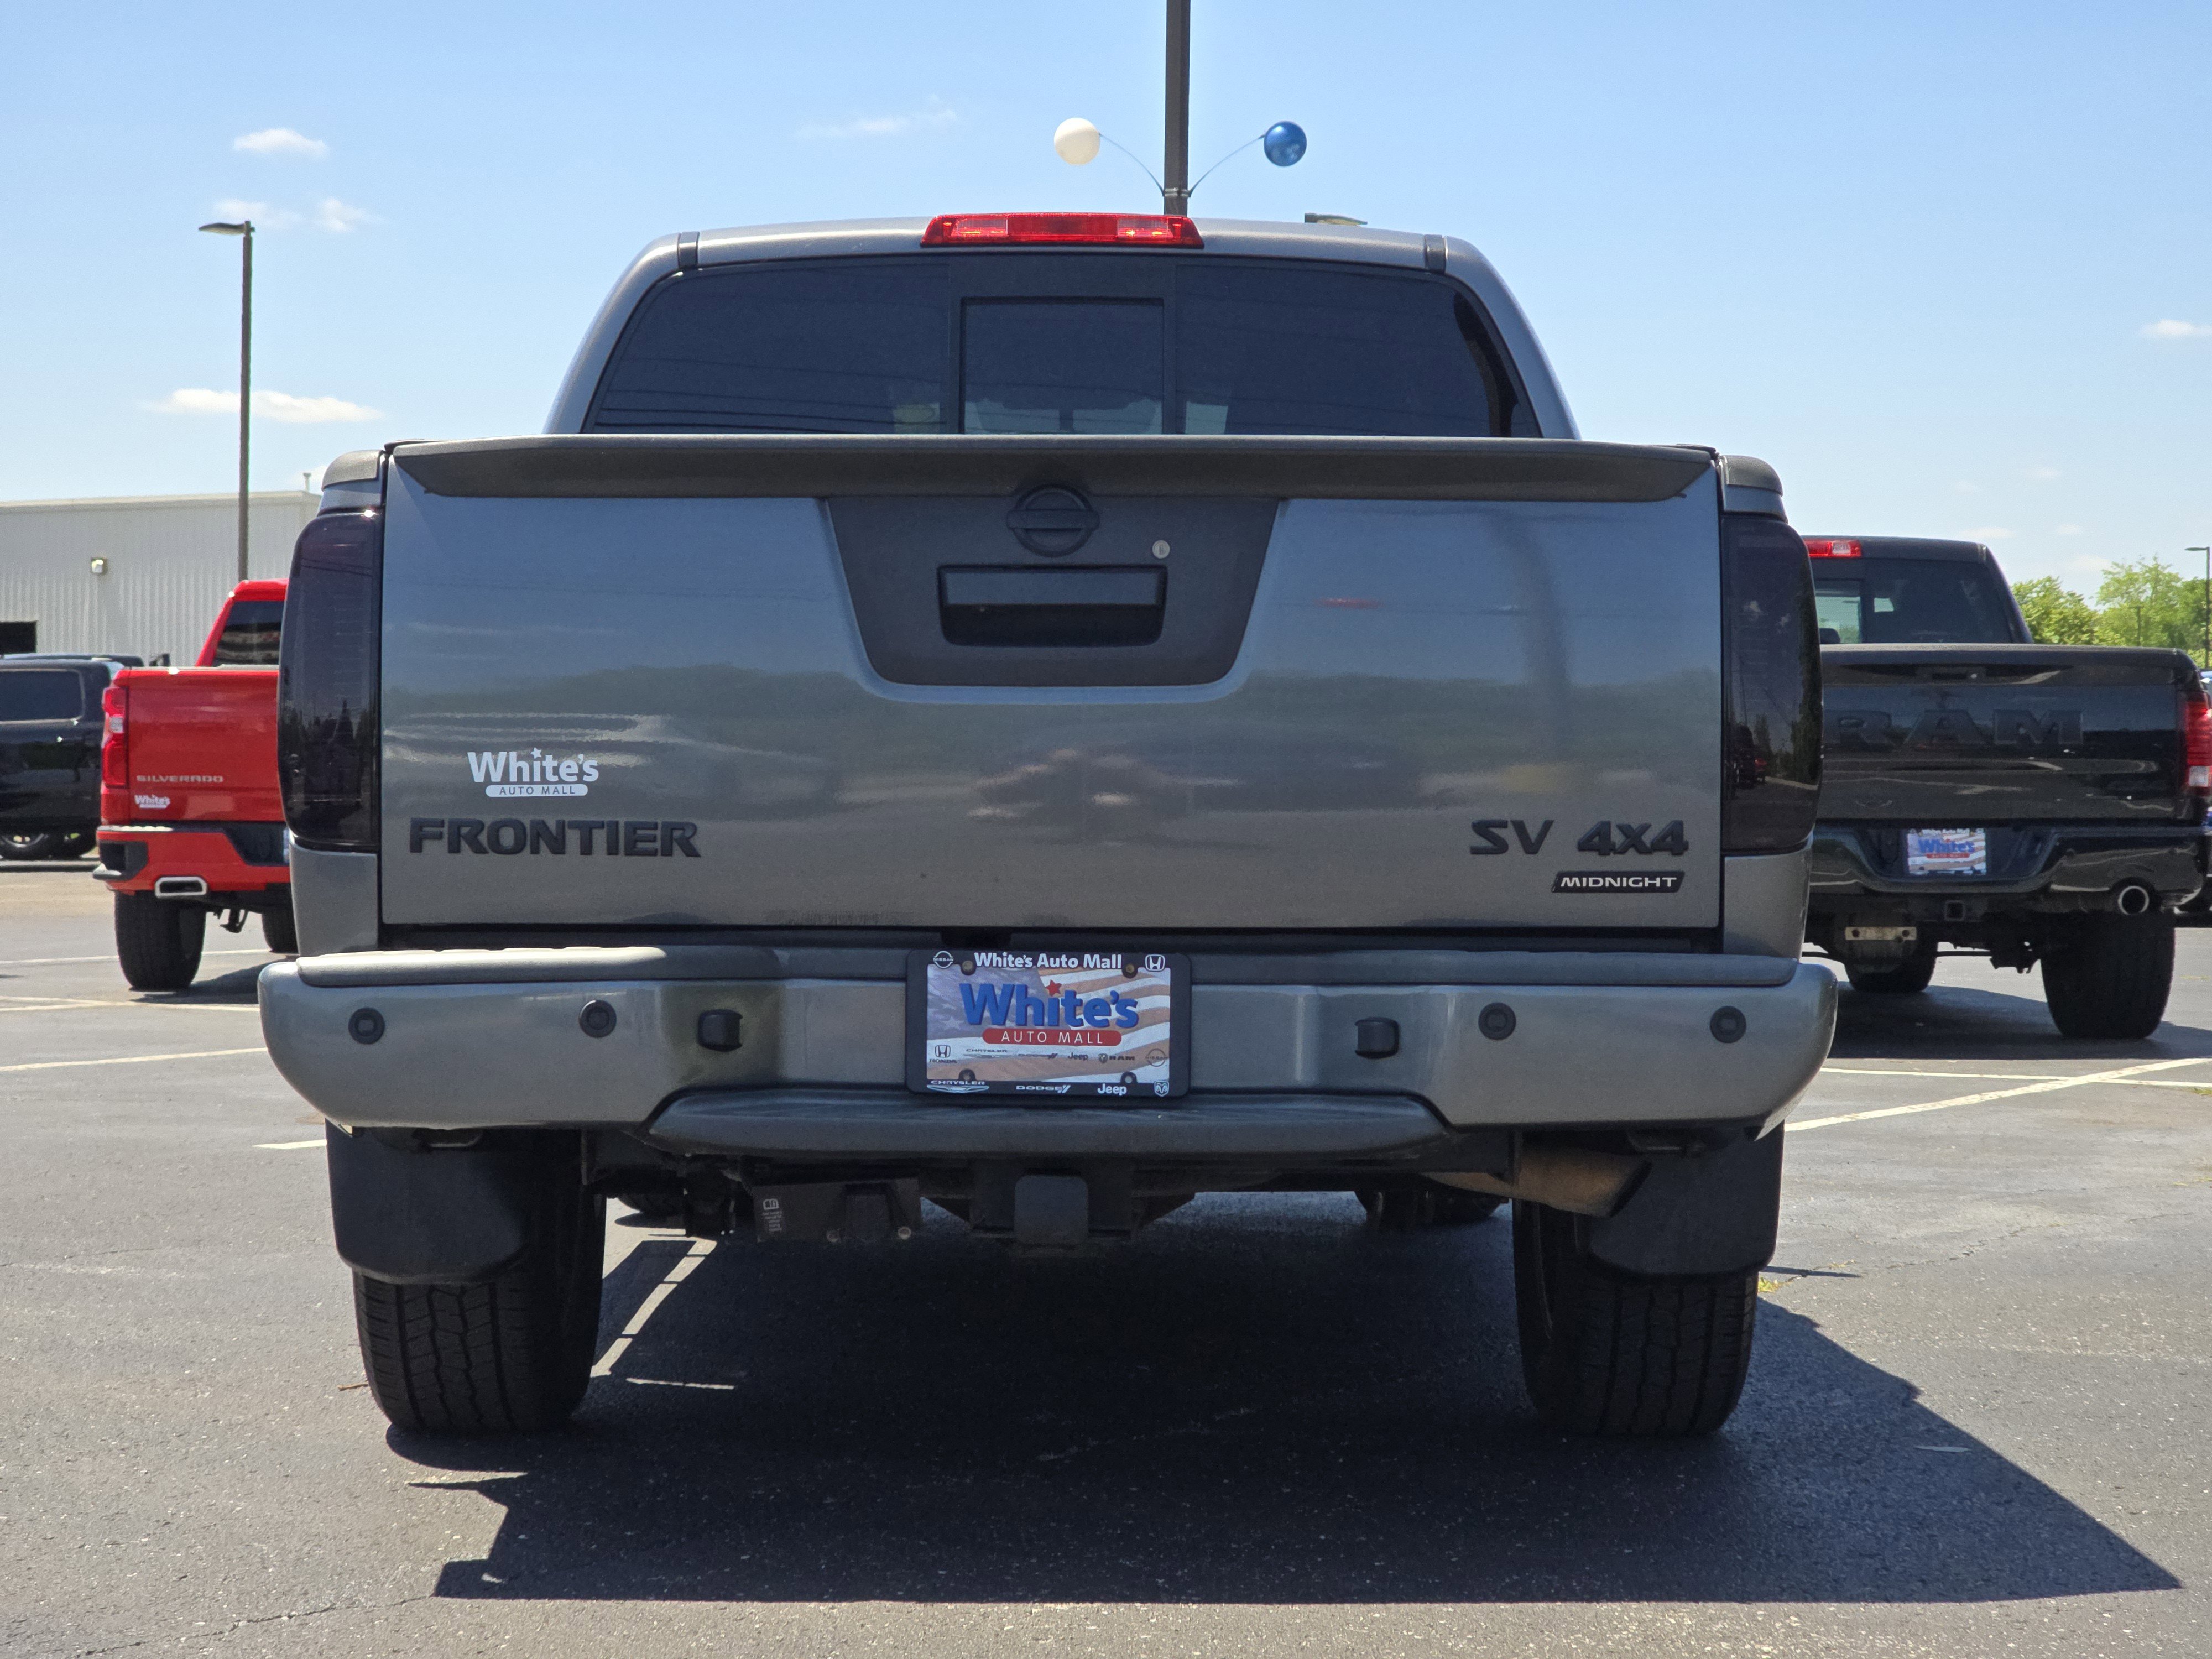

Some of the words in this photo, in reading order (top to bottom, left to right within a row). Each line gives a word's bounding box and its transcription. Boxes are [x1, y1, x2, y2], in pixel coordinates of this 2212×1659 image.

[467, 749, 599, 782] White's
[499, 786, 534, 795] AUTO
[541, 786, 575, 795] MALL
[410, 818, 701, 857] FRONTIER
[1470, 820, 1554, 855] SV
[1561, 877, 1677, 887] MIDNIGHT
[974, 952, 1033, 968] White's
[1037, 953, 1078, 968] Auto
[1083, 954, 1121, 969] Mall
[959, 982, 1139, 1028] White's
[1001, 1031, 1047, 1042] AUTO
[1058, 1032, 1103, 1044] MALL
[1067, 1052, 1089, 1061] Jeep
[1097, 1083, 1127, 1096] Jeep
